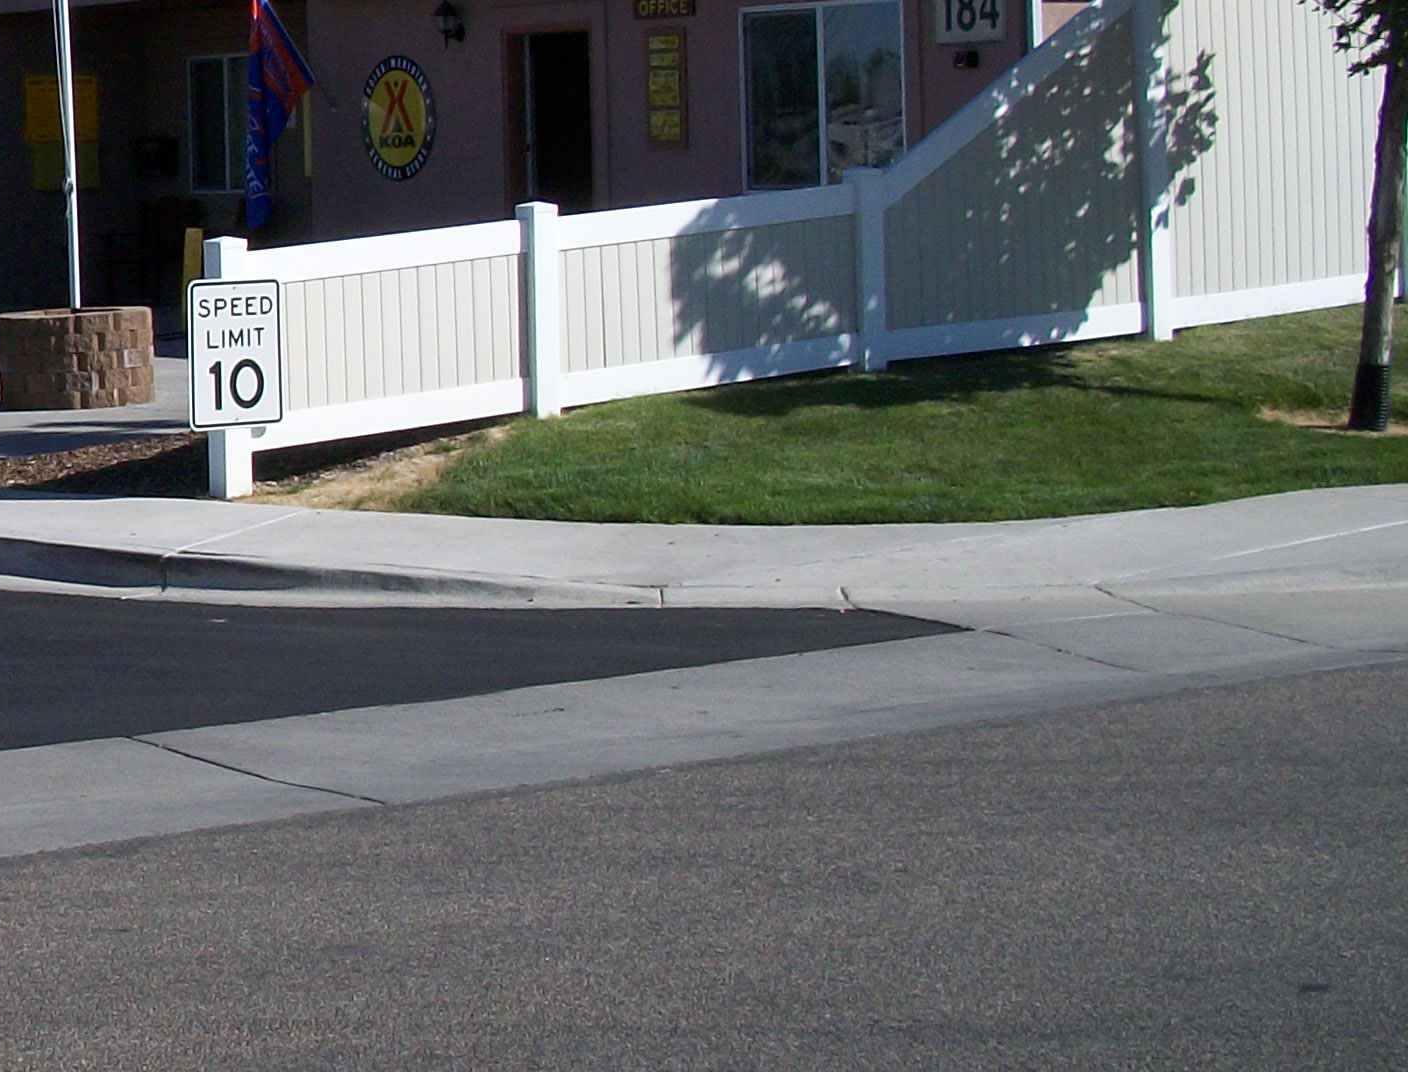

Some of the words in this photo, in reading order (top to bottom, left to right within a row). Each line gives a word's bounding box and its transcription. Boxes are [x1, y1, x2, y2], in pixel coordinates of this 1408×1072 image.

[378, 133, 416, 148] KOA
[368, 149, 403, 179] GENERAL
[406, 148, 429, 177] STORE
[197, 296, 273, 319] SPEED
[206, 327, 265, 350] LIMIT
[208, 358, 265, 411] 10
